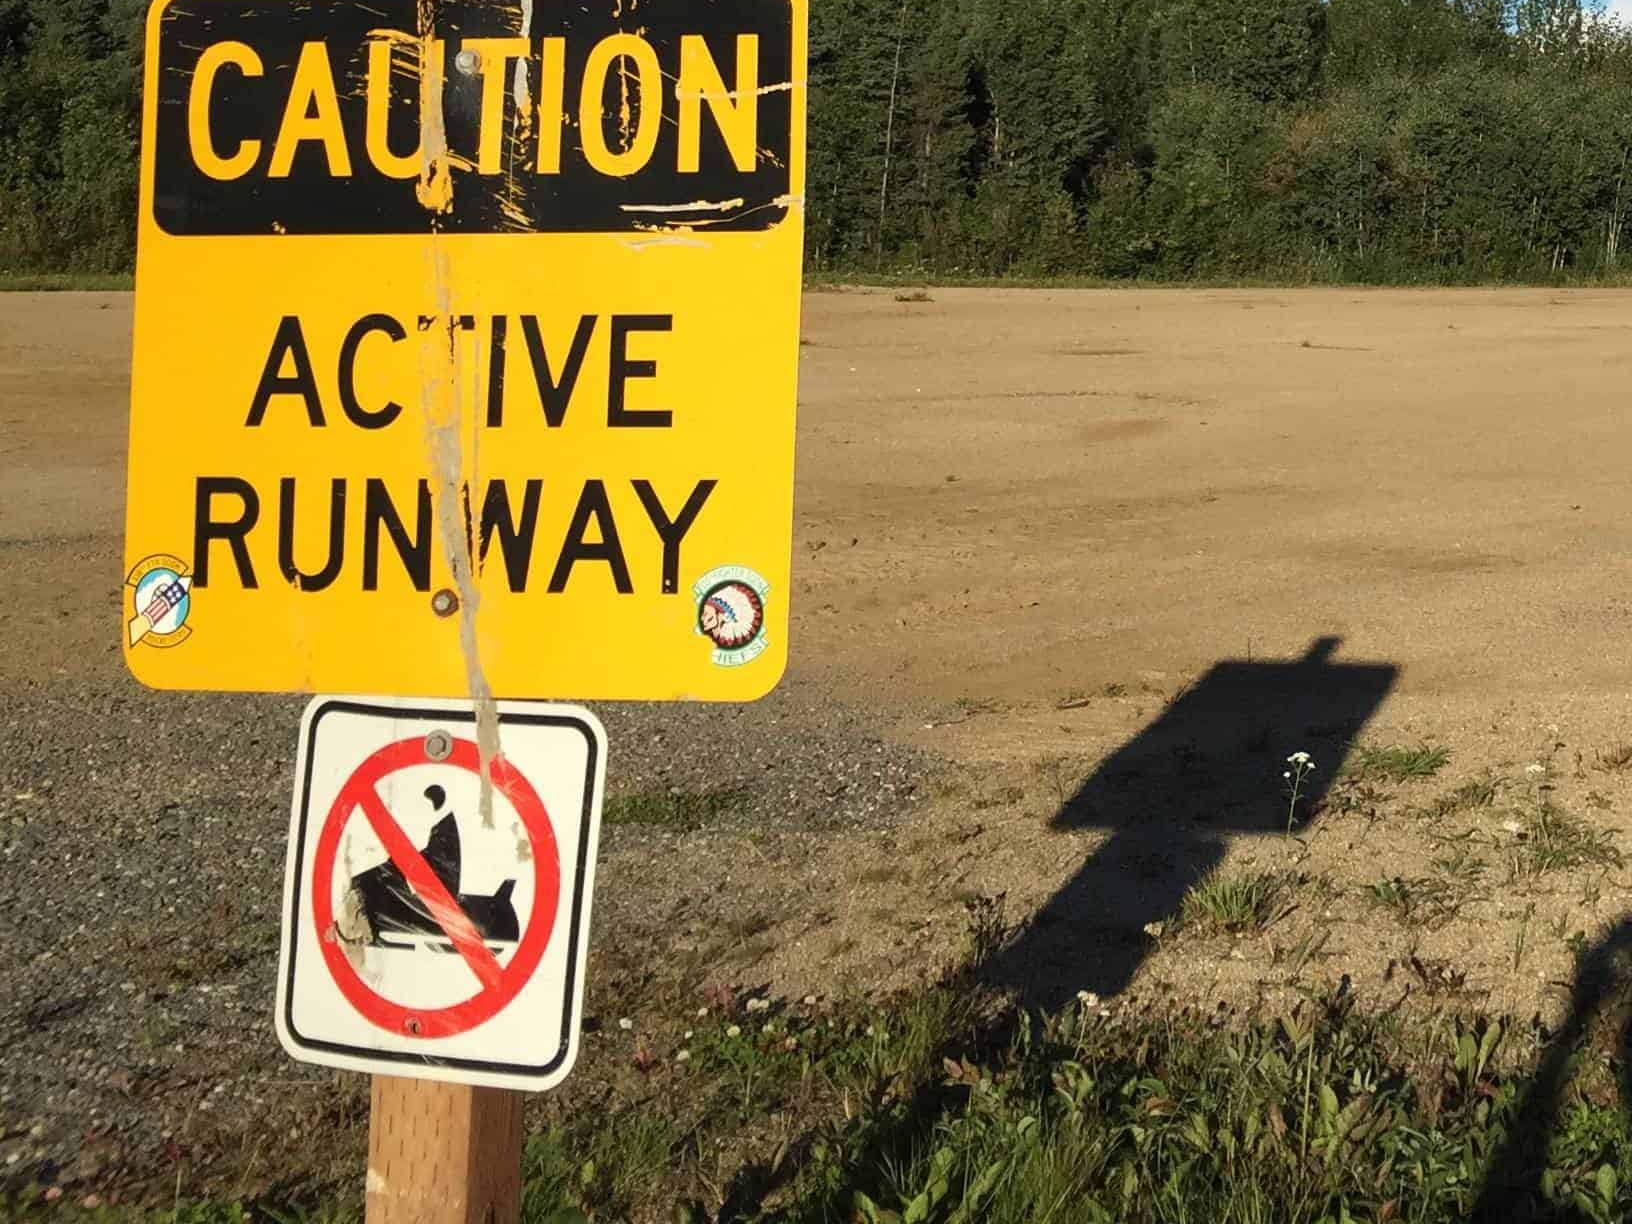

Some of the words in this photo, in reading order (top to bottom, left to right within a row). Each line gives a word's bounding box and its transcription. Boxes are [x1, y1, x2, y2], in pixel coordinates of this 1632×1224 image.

[188, 33, 758, 181] CAUTION
[245, 313, 674, 430] ACIVE
[193, 477, 718, 594] RUNWAY
